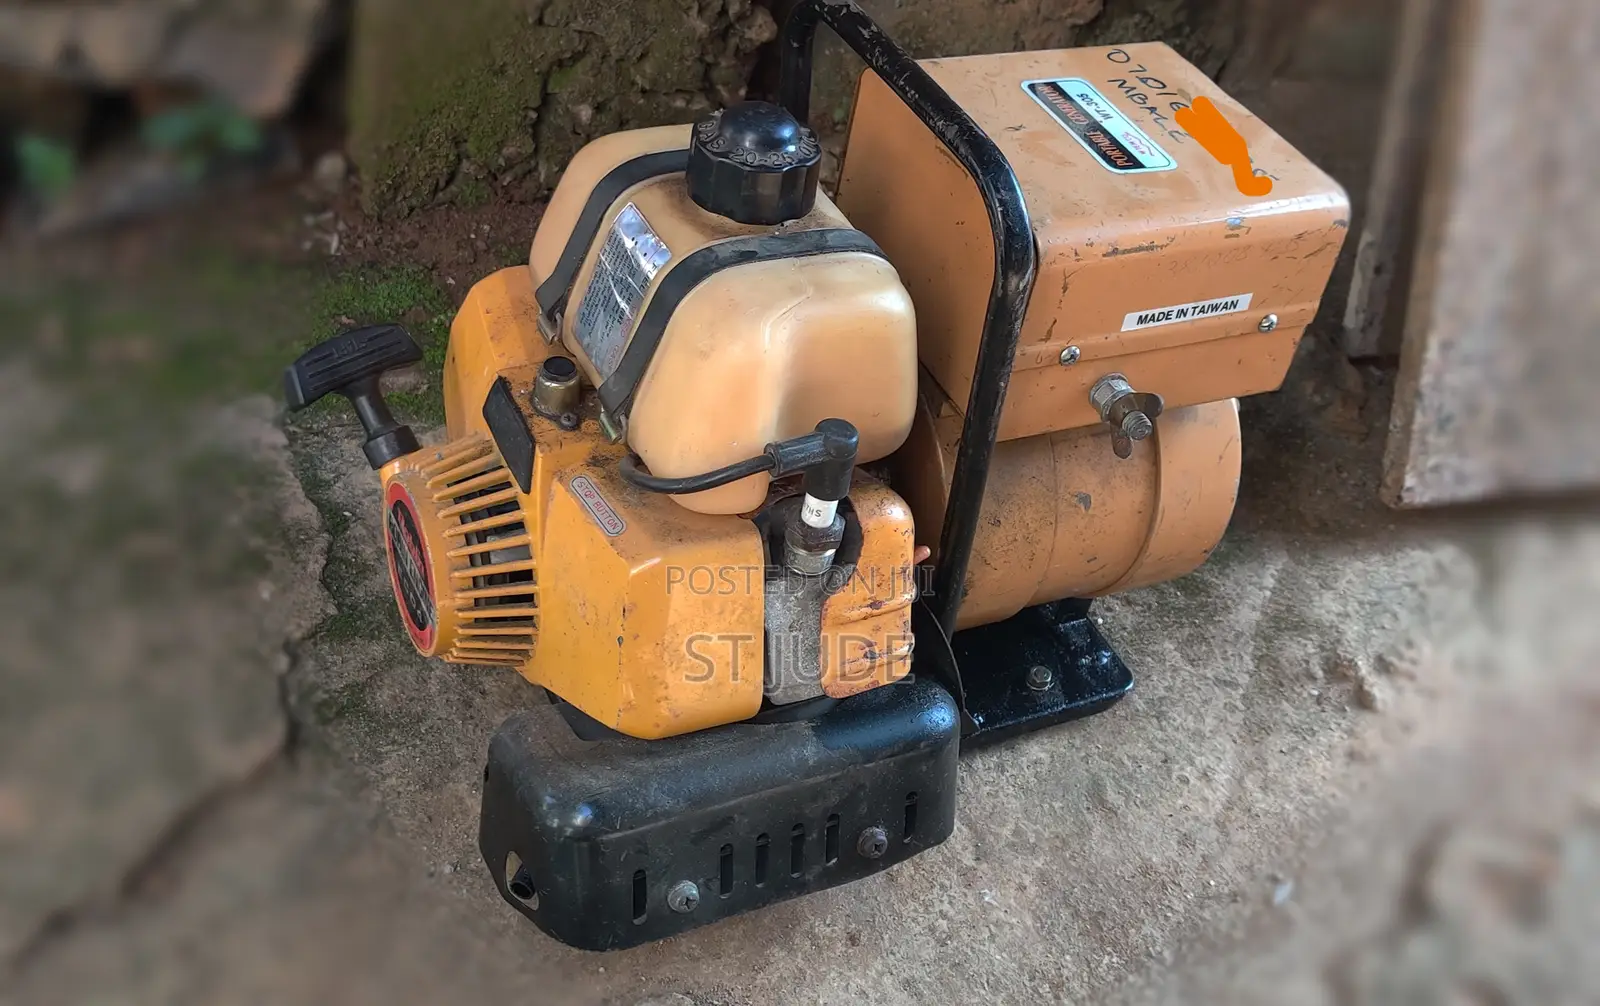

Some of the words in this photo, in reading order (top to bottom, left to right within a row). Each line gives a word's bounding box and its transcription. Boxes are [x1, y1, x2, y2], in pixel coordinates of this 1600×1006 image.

[1037, 85, 1088, 125] GENERATOR
[1076, 93, 1113, 121] WT-305
[698, 121, 726, 149] GAS
[1087, 131, 1133, 167] PORTABLE
[1136, 310, 1173, 326] MADE
[1176, 308, 1189, 319] IN
[1191, 299, 1239, 316] TAIWAN
[577, 481, 595, 499] STOP
[593, 501, 619, 530] BUTTON
